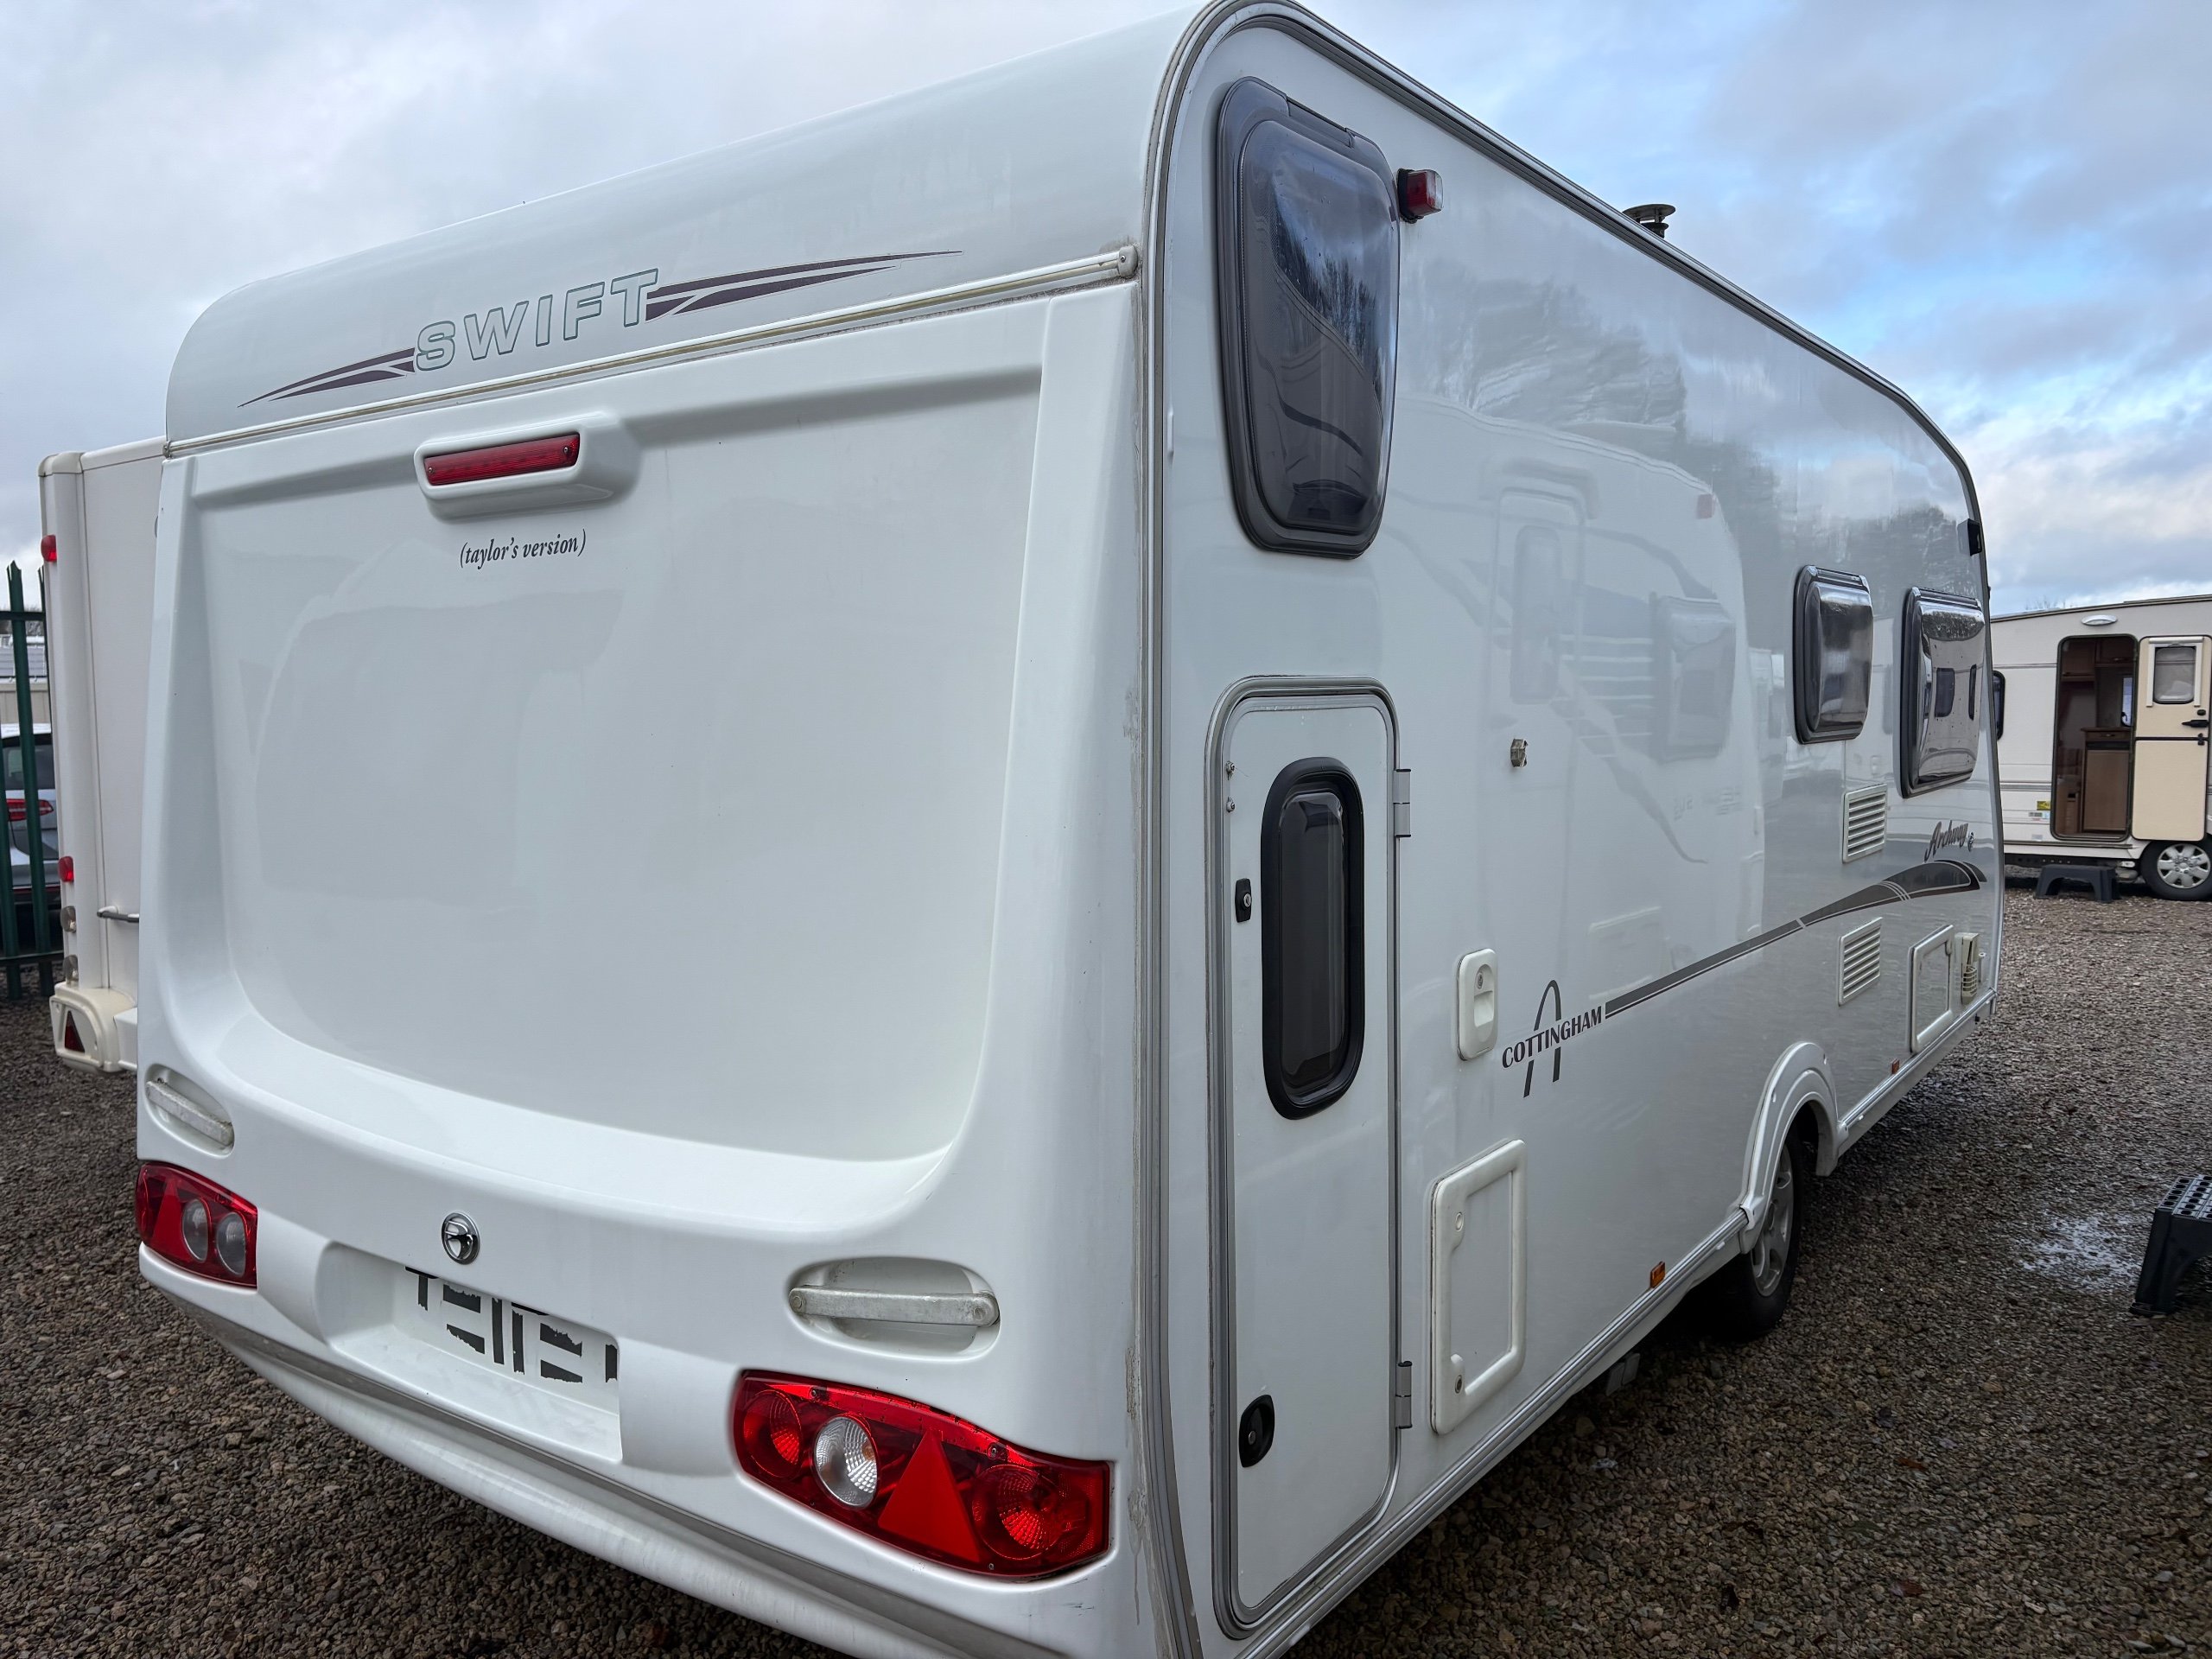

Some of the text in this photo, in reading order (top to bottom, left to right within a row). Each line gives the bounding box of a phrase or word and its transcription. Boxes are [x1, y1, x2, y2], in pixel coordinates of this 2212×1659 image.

[416, 268, 659, 372] SWIFT
[460, 528, 586, 569] (taylor's version)
[1502, 1005, 1602, 1068] COTTINGHAM
